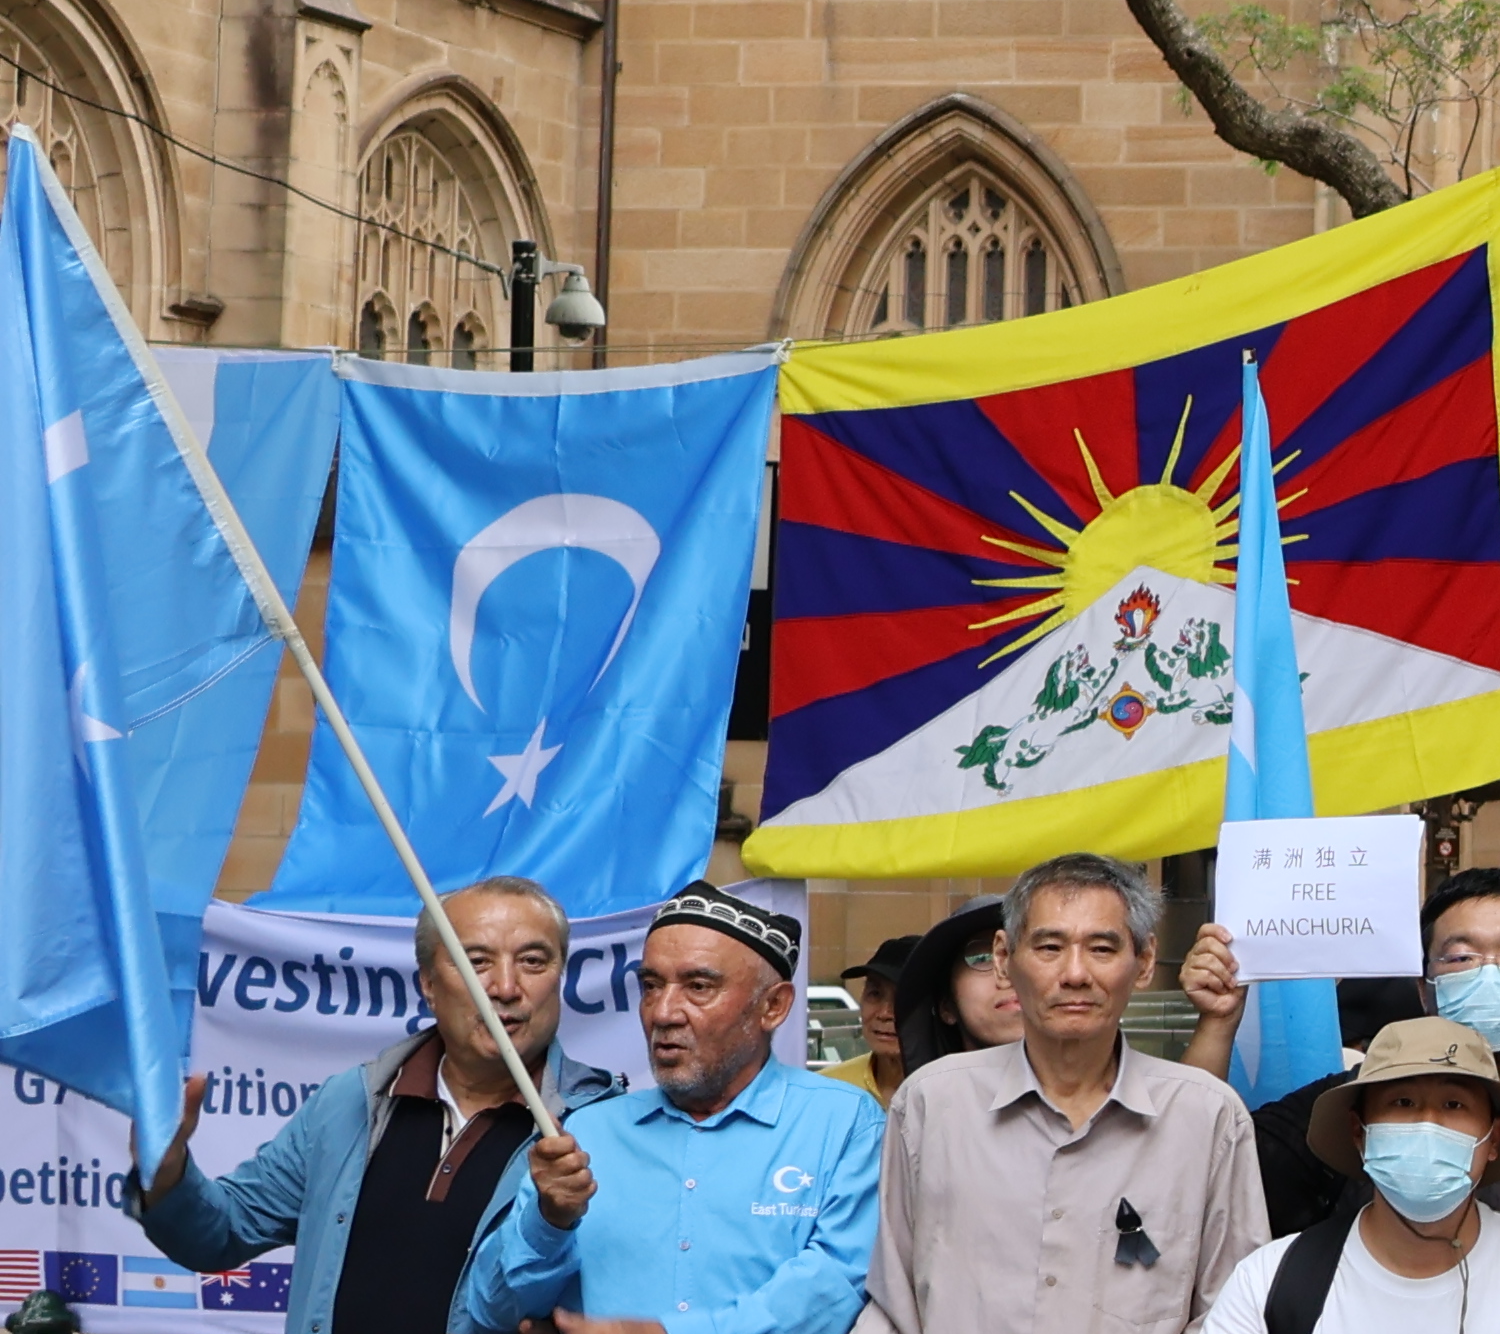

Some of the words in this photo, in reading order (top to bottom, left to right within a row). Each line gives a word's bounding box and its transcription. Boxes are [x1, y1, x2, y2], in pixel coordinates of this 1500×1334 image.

[1252, 845, 1369, 870] 满洲独立
[1290, 882, 1337, 901] FREE
[1245, 916, 1375, 936] MANCHURIA
[751, 1202, 776, 1215] East
